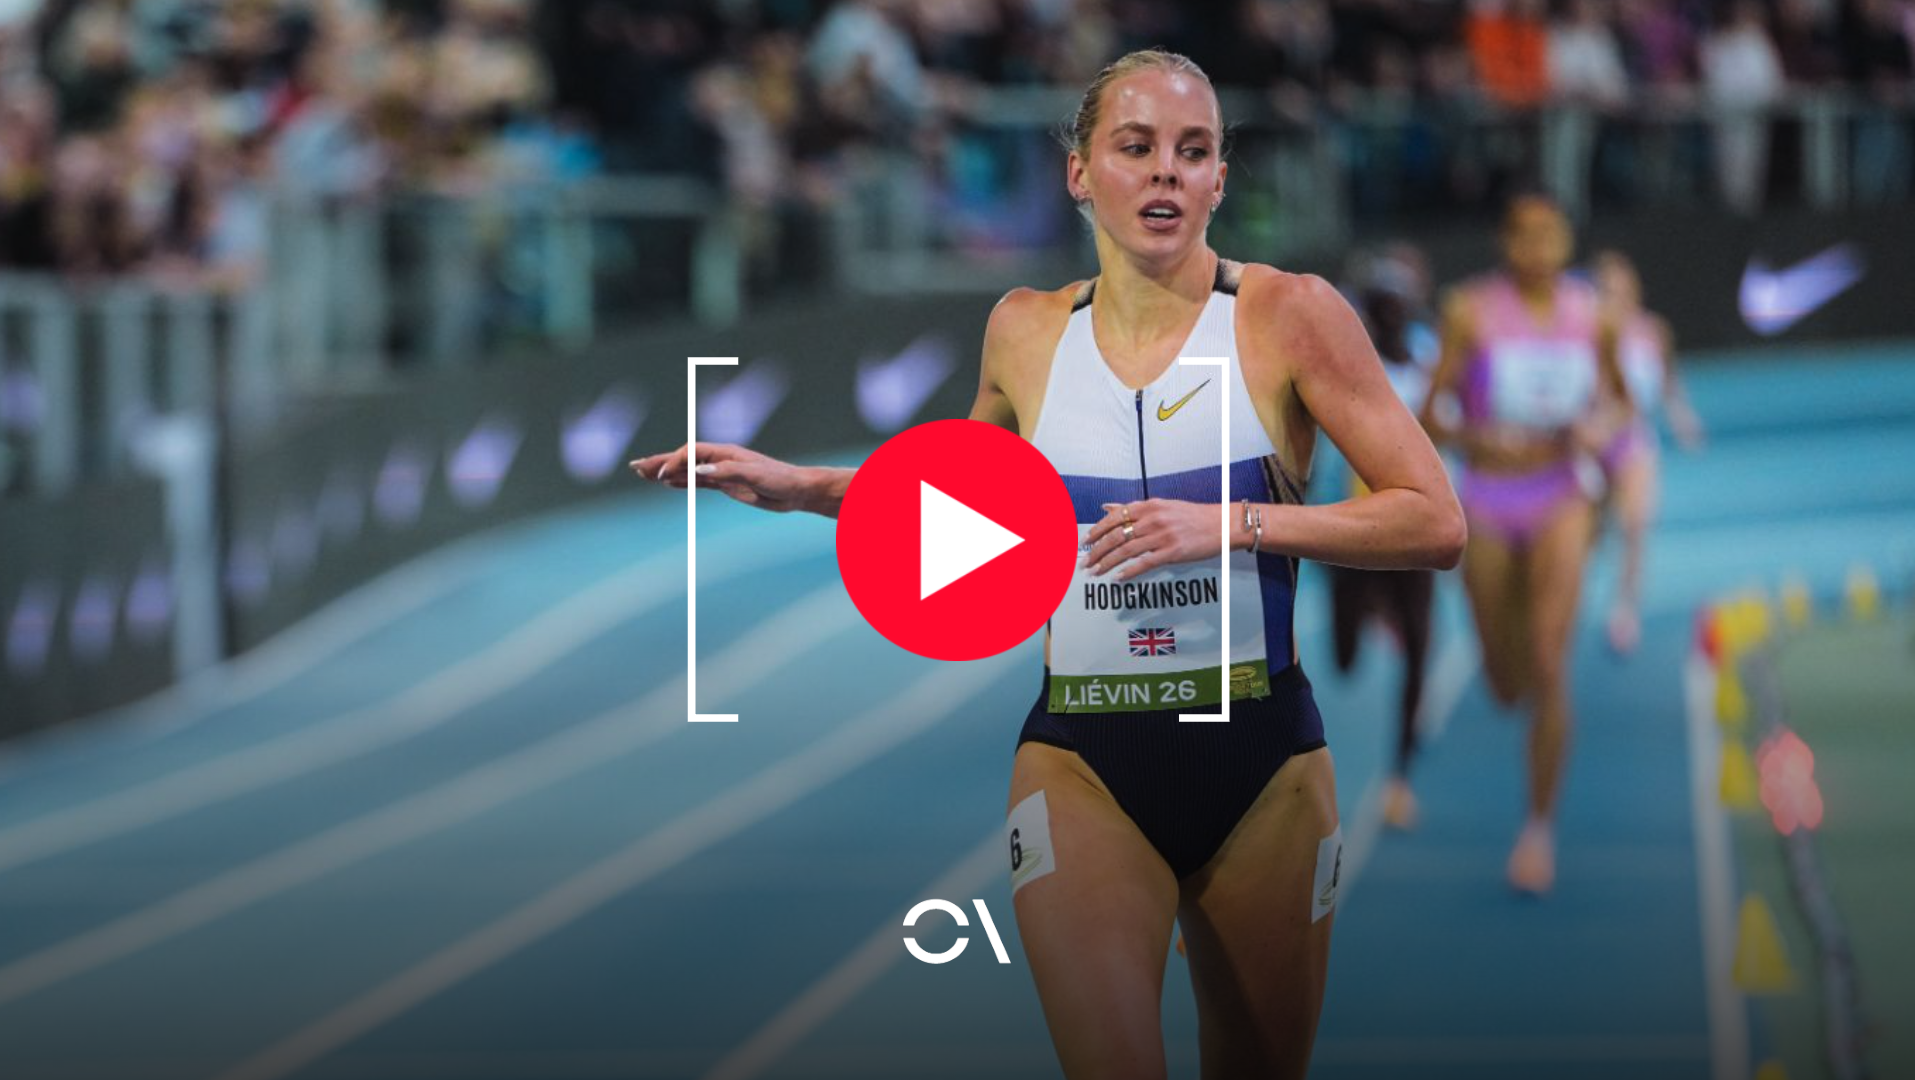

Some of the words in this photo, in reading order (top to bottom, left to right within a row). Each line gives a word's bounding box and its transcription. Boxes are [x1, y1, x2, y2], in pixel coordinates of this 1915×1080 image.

[1084, 576, 1219, 610] HODGKINSON
[1065, 678, 1151, 705] LIÉVIN
[1158, 680, 1197, 702] 26
[1010, 827, 1022, 872] 6
